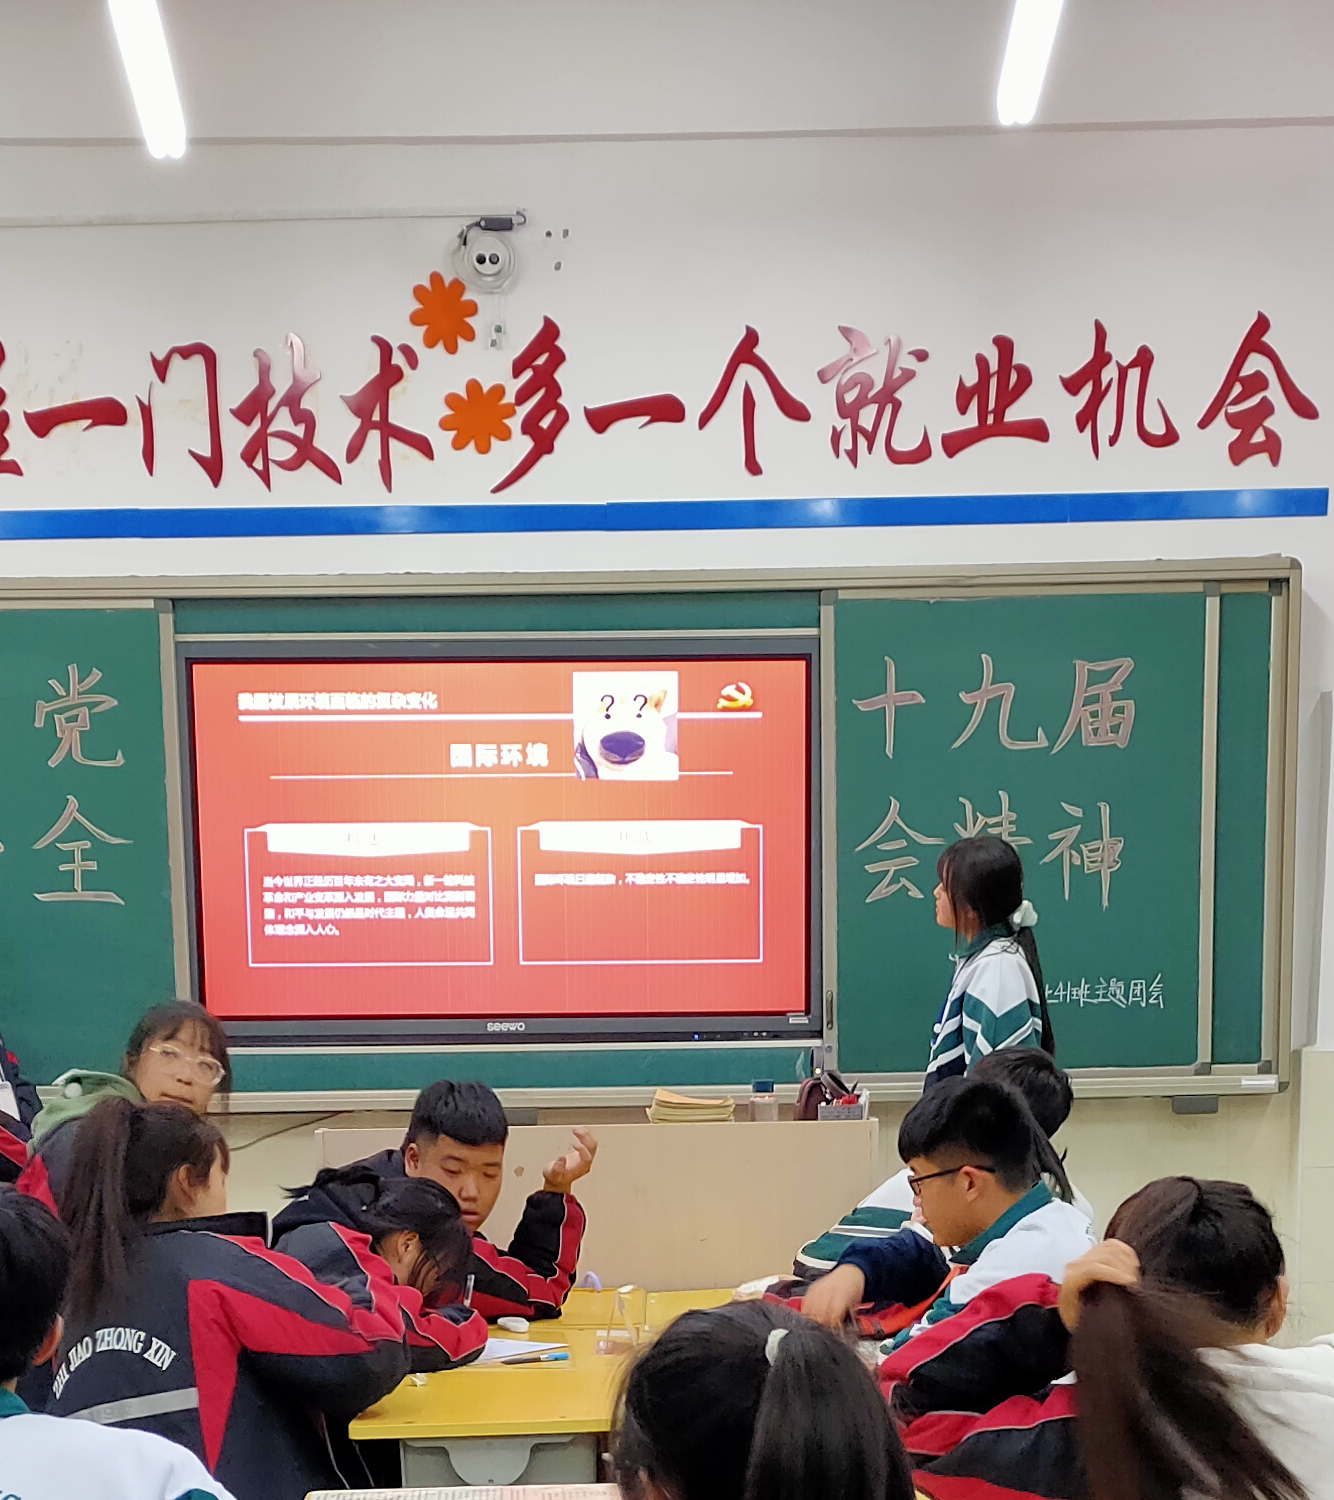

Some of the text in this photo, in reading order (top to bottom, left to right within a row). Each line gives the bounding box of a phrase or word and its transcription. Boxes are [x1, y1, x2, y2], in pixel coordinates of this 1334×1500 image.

[489, 310, 1322, 497] 多一个就业机会
[852, 653, 1135, 759] 十九届
[68, 1335, 94, 1372] JIAO
[95, 1326, 146, 1355] ZHONG
[143, 1336, 177, 1371] XIN
